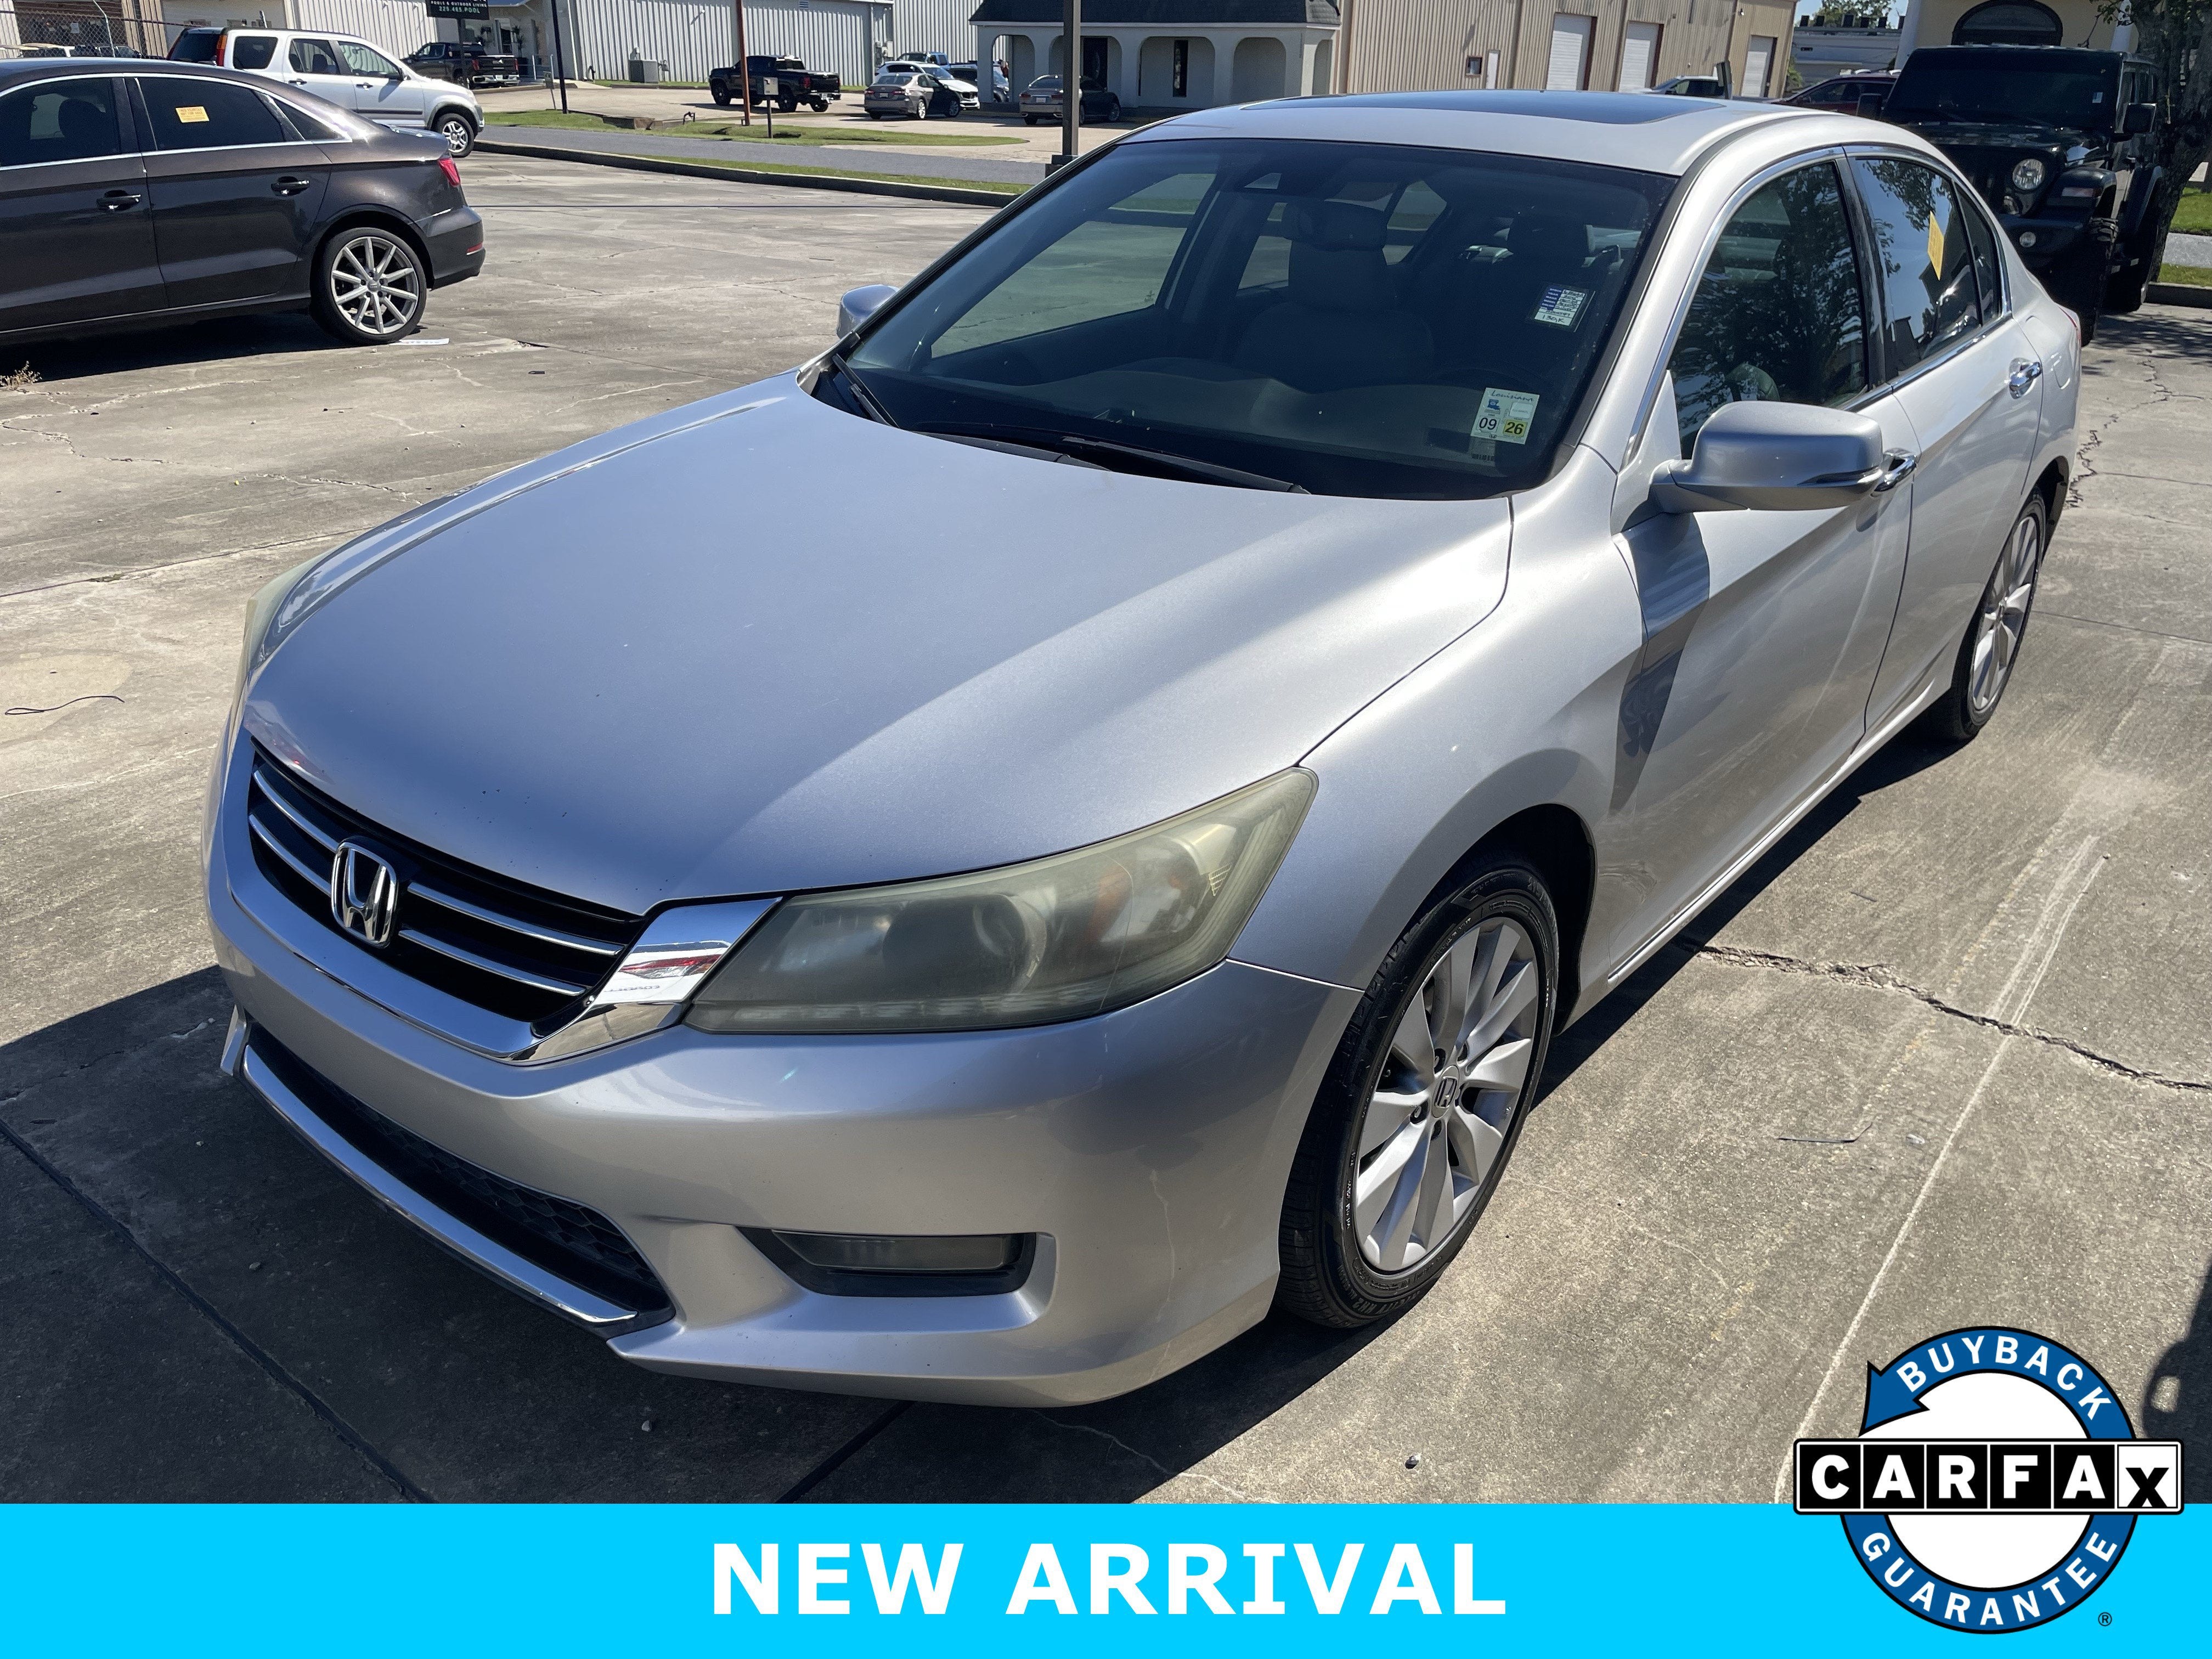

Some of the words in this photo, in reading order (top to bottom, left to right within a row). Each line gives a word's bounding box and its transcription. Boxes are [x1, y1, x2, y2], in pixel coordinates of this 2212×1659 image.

[1491, 390, 1534, 401] Louisiana
[1479, 417, 1497, 430] 09
[1505, 421, 1524, 435] 26
